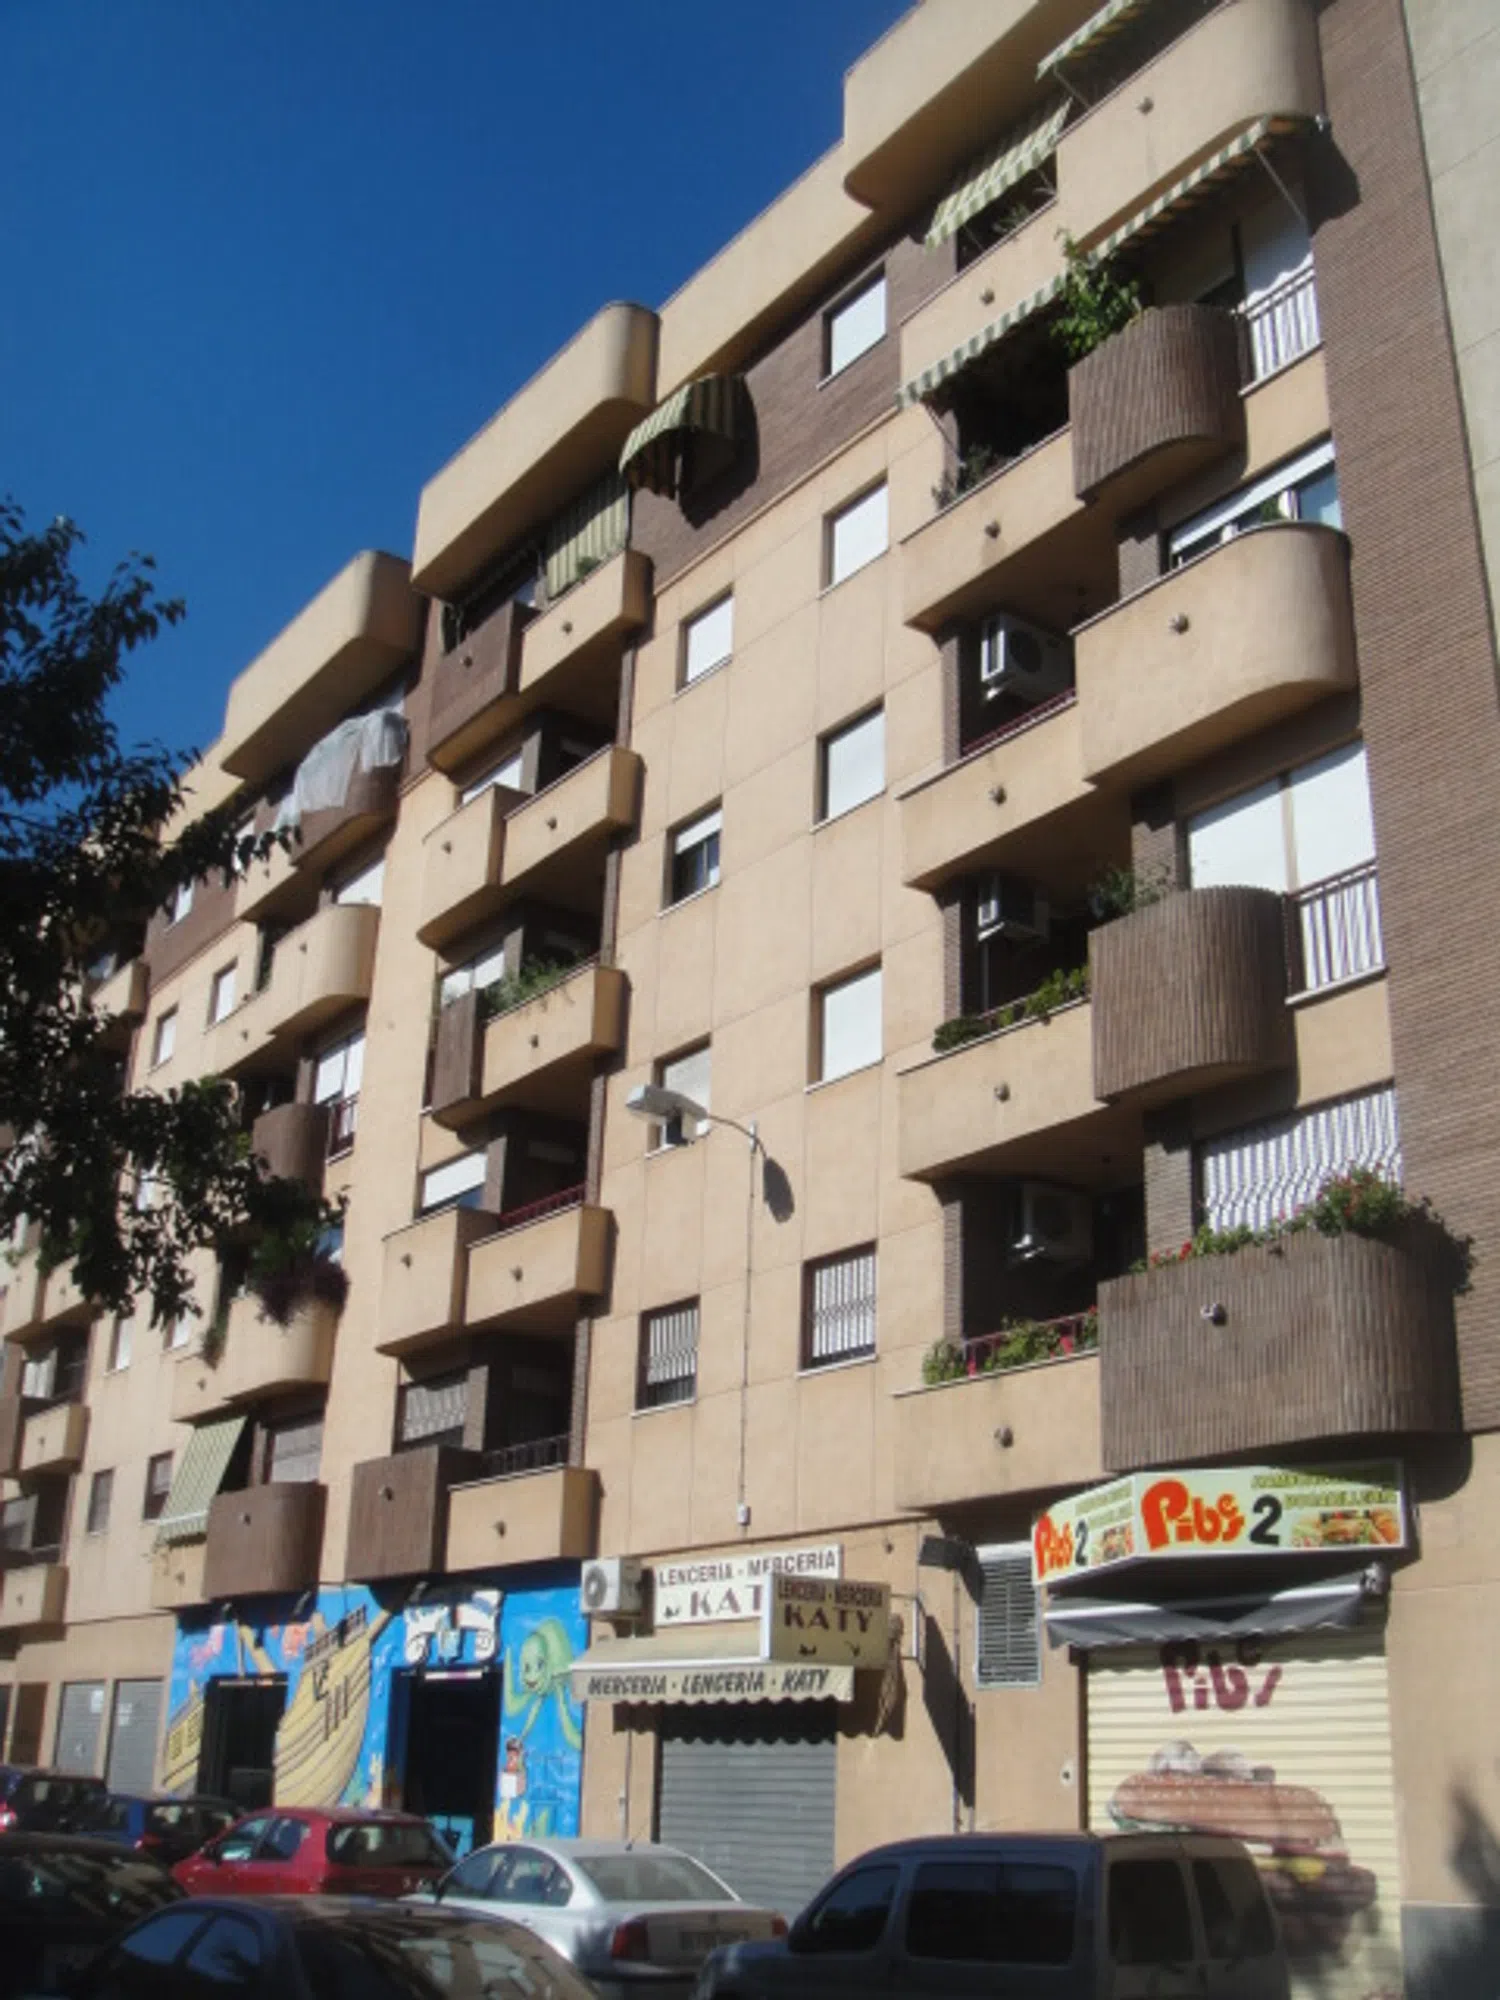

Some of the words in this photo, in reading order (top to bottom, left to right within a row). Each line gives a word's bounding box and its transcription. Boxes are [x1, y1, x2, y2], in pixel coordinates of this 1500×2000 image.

[1140, 1479, 1245, 1551] Pibs
[1249, 1494, 1283, 1546] 2
[1035, 1512, 1073, 1579] Pibs
[1075, 1519, 1088, 1567] 2
[658, 1563, 733, 1588] LENCERIA
[749, 1550, 836, 1576] MERCERIA
[690, 1584, 763, 1617] KAT
[783, 1603, 873, 1633] KATY
[587, 1675, 667, 1695] MERCERIA
[681, 1671, 765, 1694] LENCERIA
[781, 1668, 830, 1692] KATY
